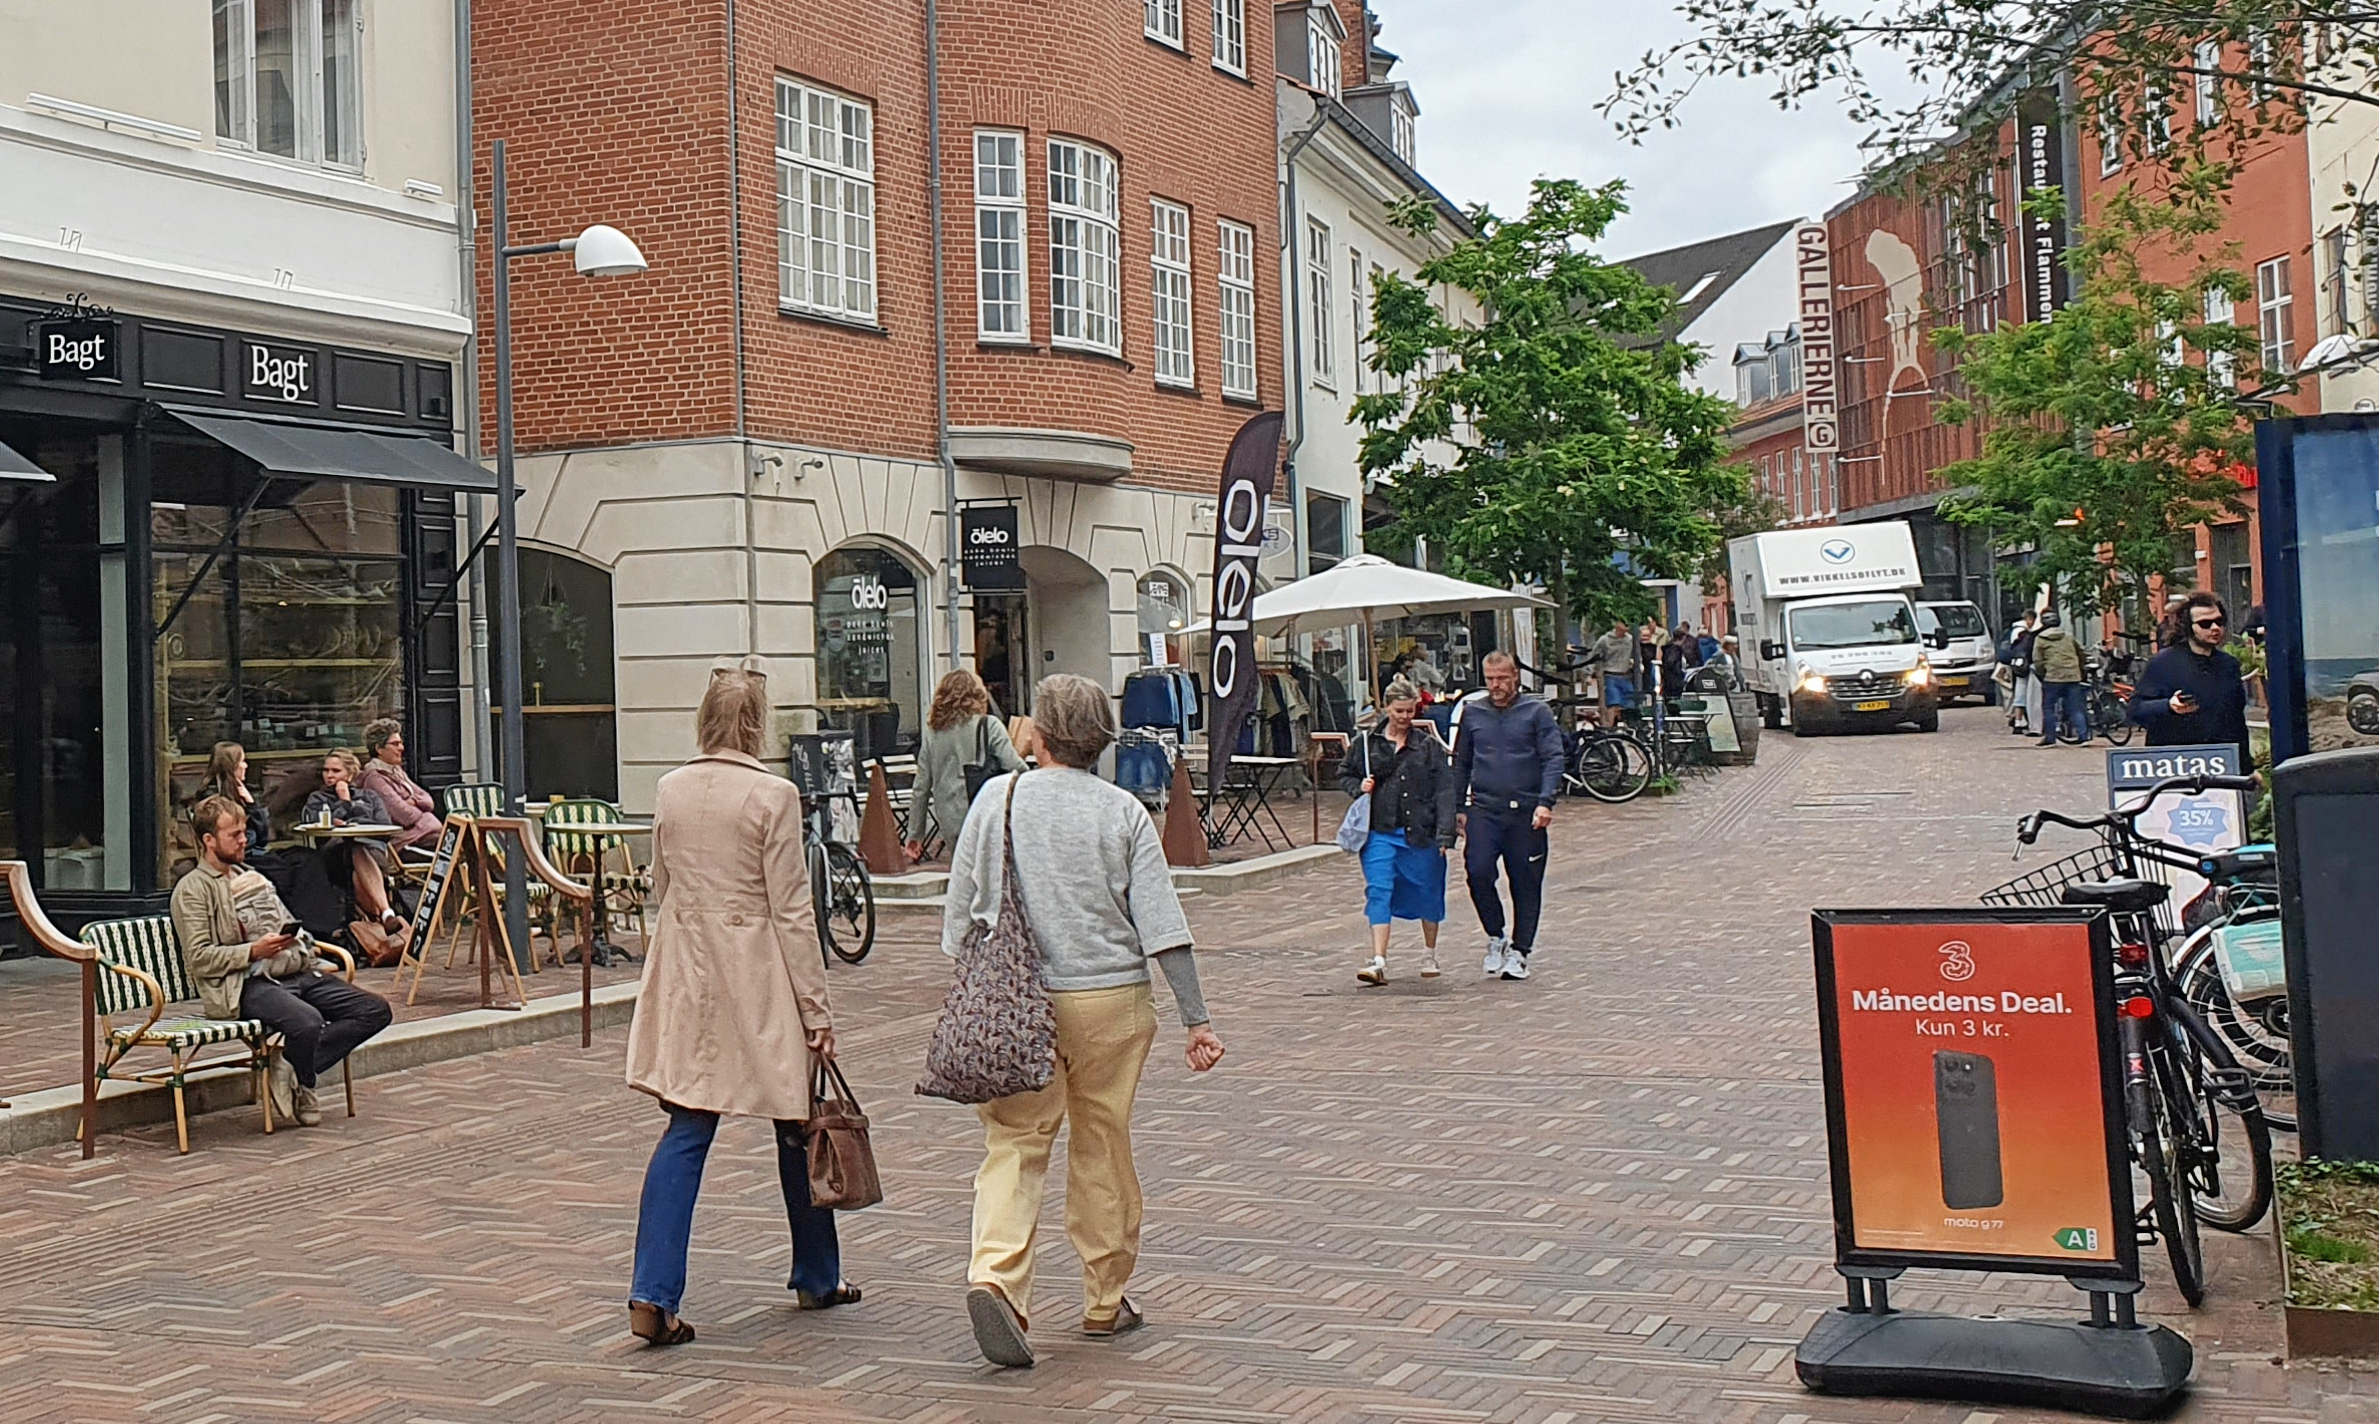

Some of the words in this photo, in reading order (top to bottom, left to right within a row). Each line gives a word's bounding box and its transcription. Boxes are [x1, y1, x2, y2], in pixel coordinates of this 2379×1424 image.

[2031, 125, 2051, 231] Restaut
[1797, 226, 1835, 416] GALLERIERNE
[48, 333, 105, 371] Bagt
[250, 344, 309, 401] Bagt
[2122, 754, 2226, 779] matas
[2179, 809, 2214, 827] 35%
[1852, 986, 1996, 1013] Månedens
[2001, 991, 2072, 1015] Deal.
[1915, 1018, 1955, 1036] Kun
[1962, 1019, 1976, 1037] 3
[1983, 1020, 2010, 1037] kr.
[1943, 1217, 1979, 1229] moto
[2067, 1230, 2084, 1247] A
